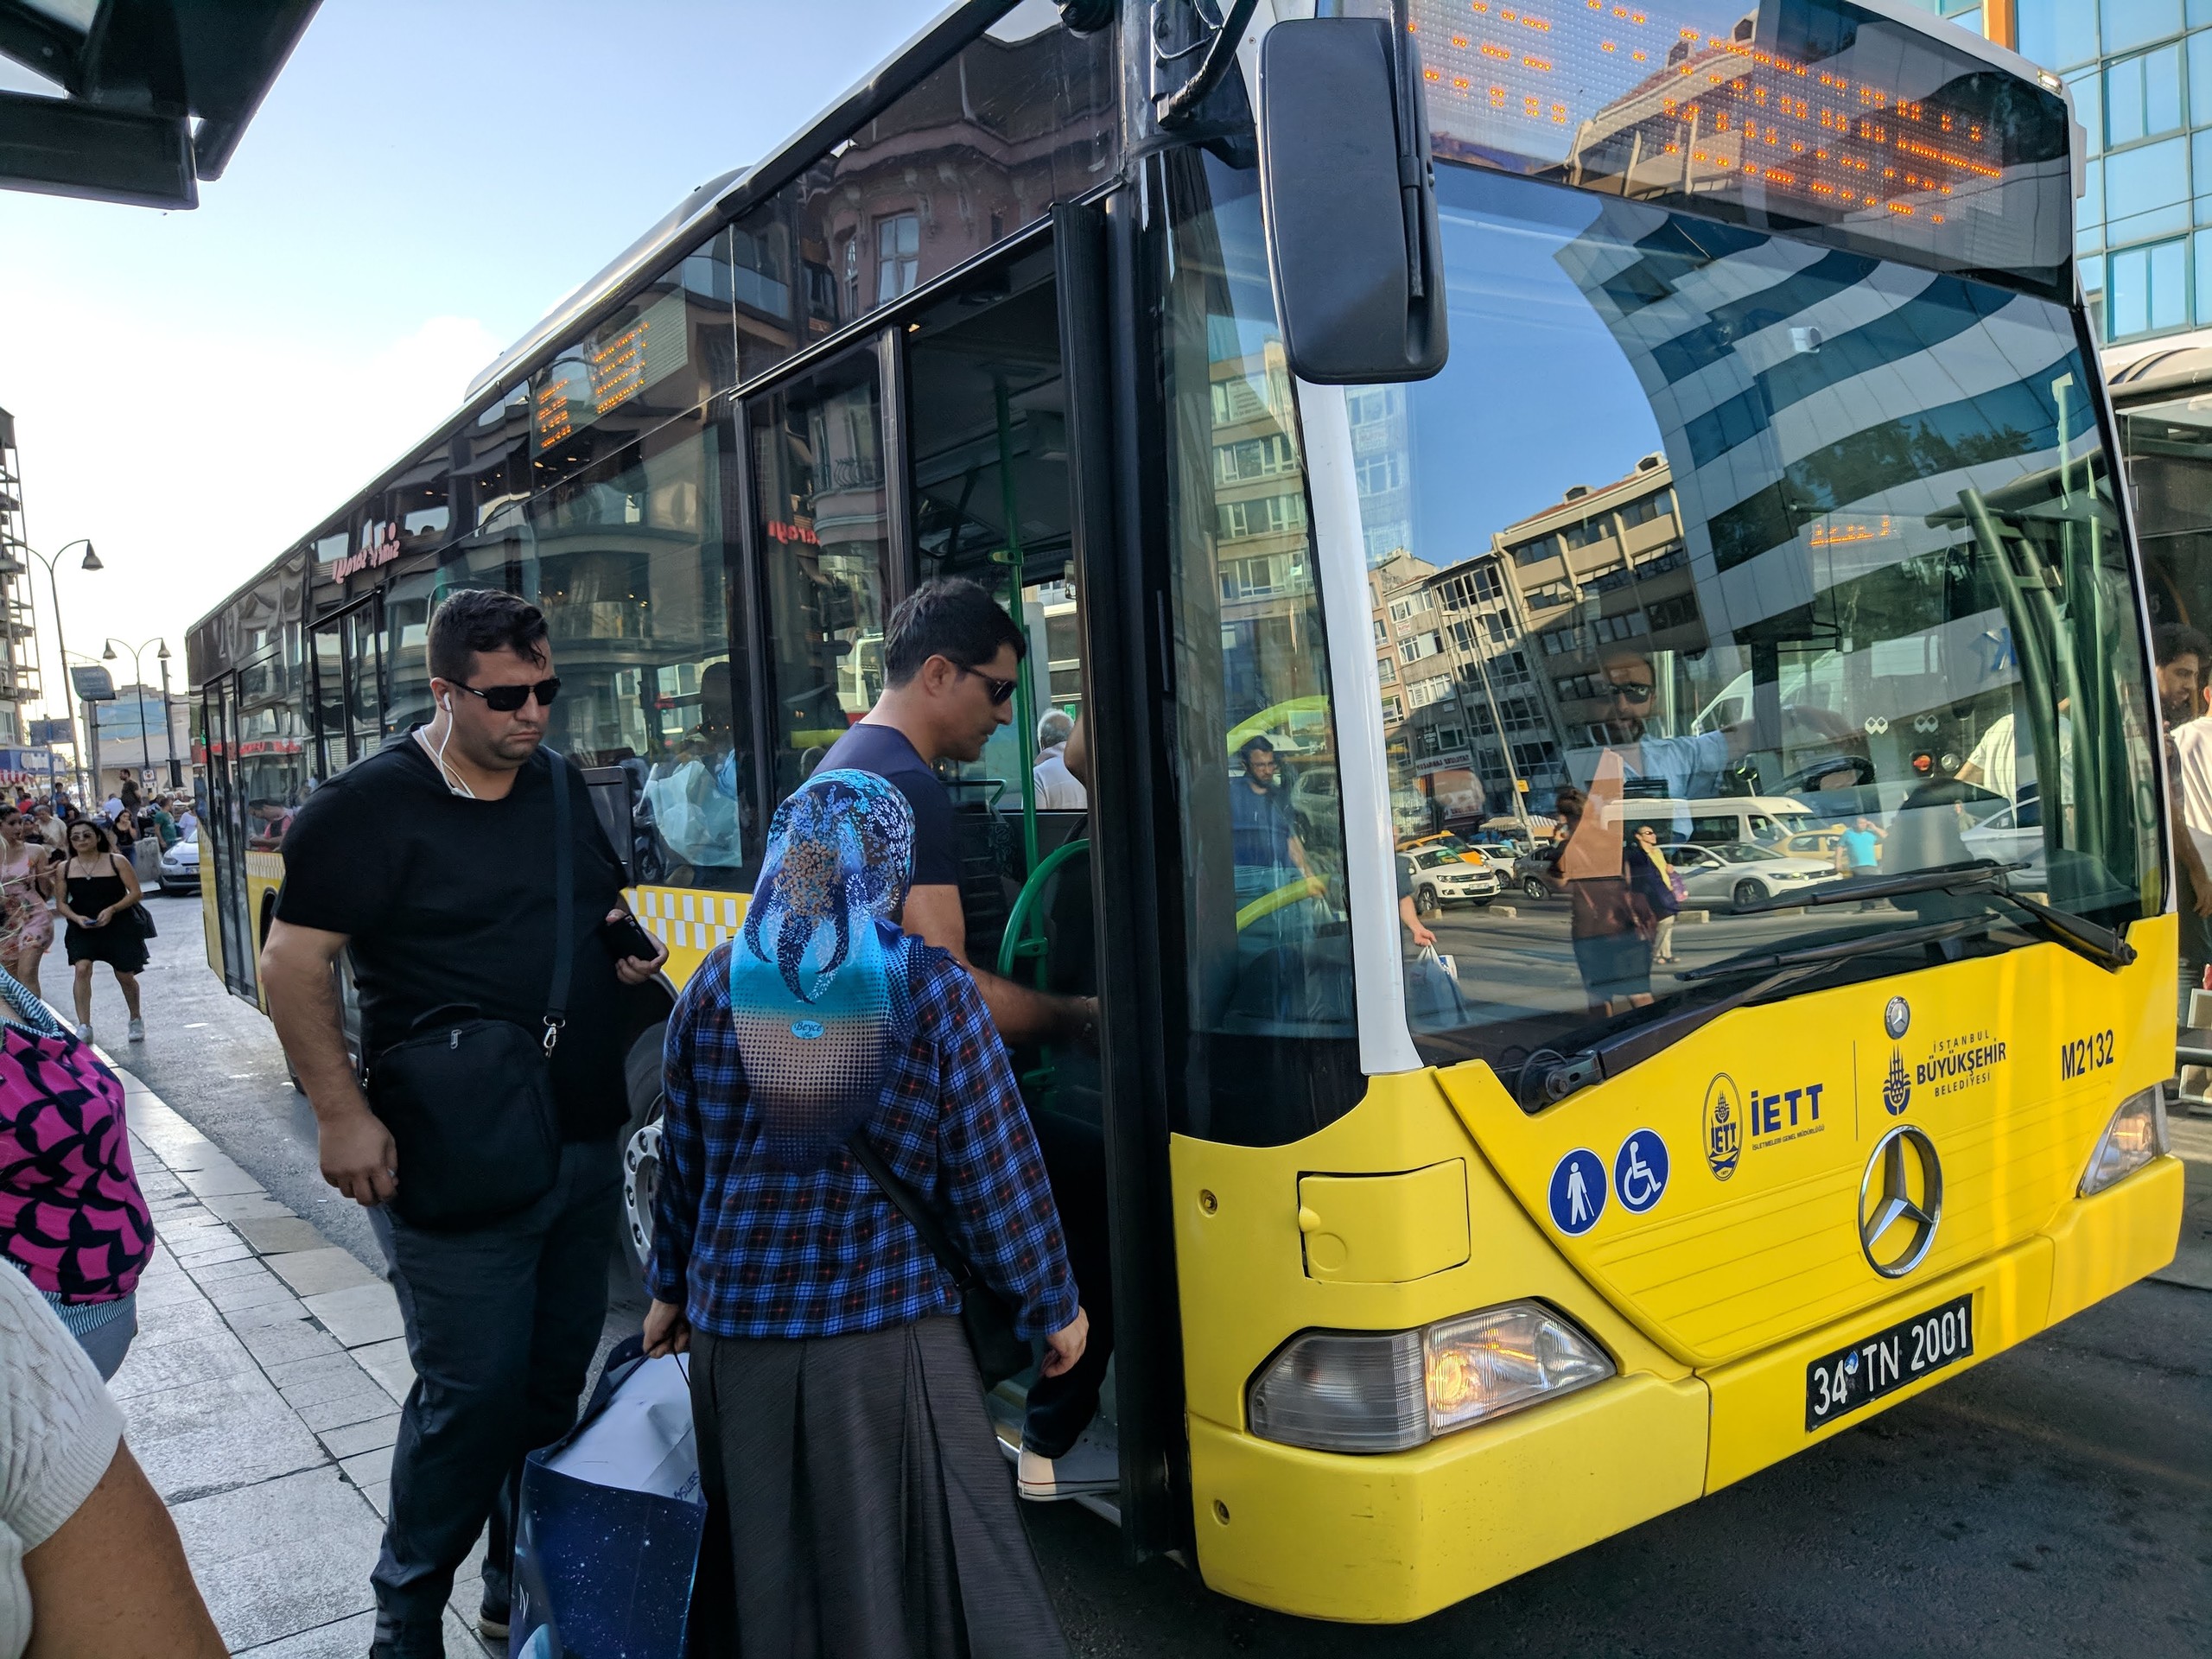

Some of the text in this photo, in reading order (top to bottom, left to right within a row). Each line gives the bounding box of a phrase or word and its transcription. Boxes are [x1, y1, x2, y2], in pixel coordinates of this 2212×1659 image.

[1916, 1037, 2006, 1085] BÜYÜKŞEHİR
[1933, 1029, 1990, 1053] İSTANBUL
[2062, 1029, 2114, 1082] M2132
[1935, 1069, 1991, 1097] BELEDİYESİ
[1751, 1083, 1823, 1137] İETT
[1782, 1132, 1796, 1143] GENEL
[1814, 1306, 1967, 1415] 34 TN 2001
